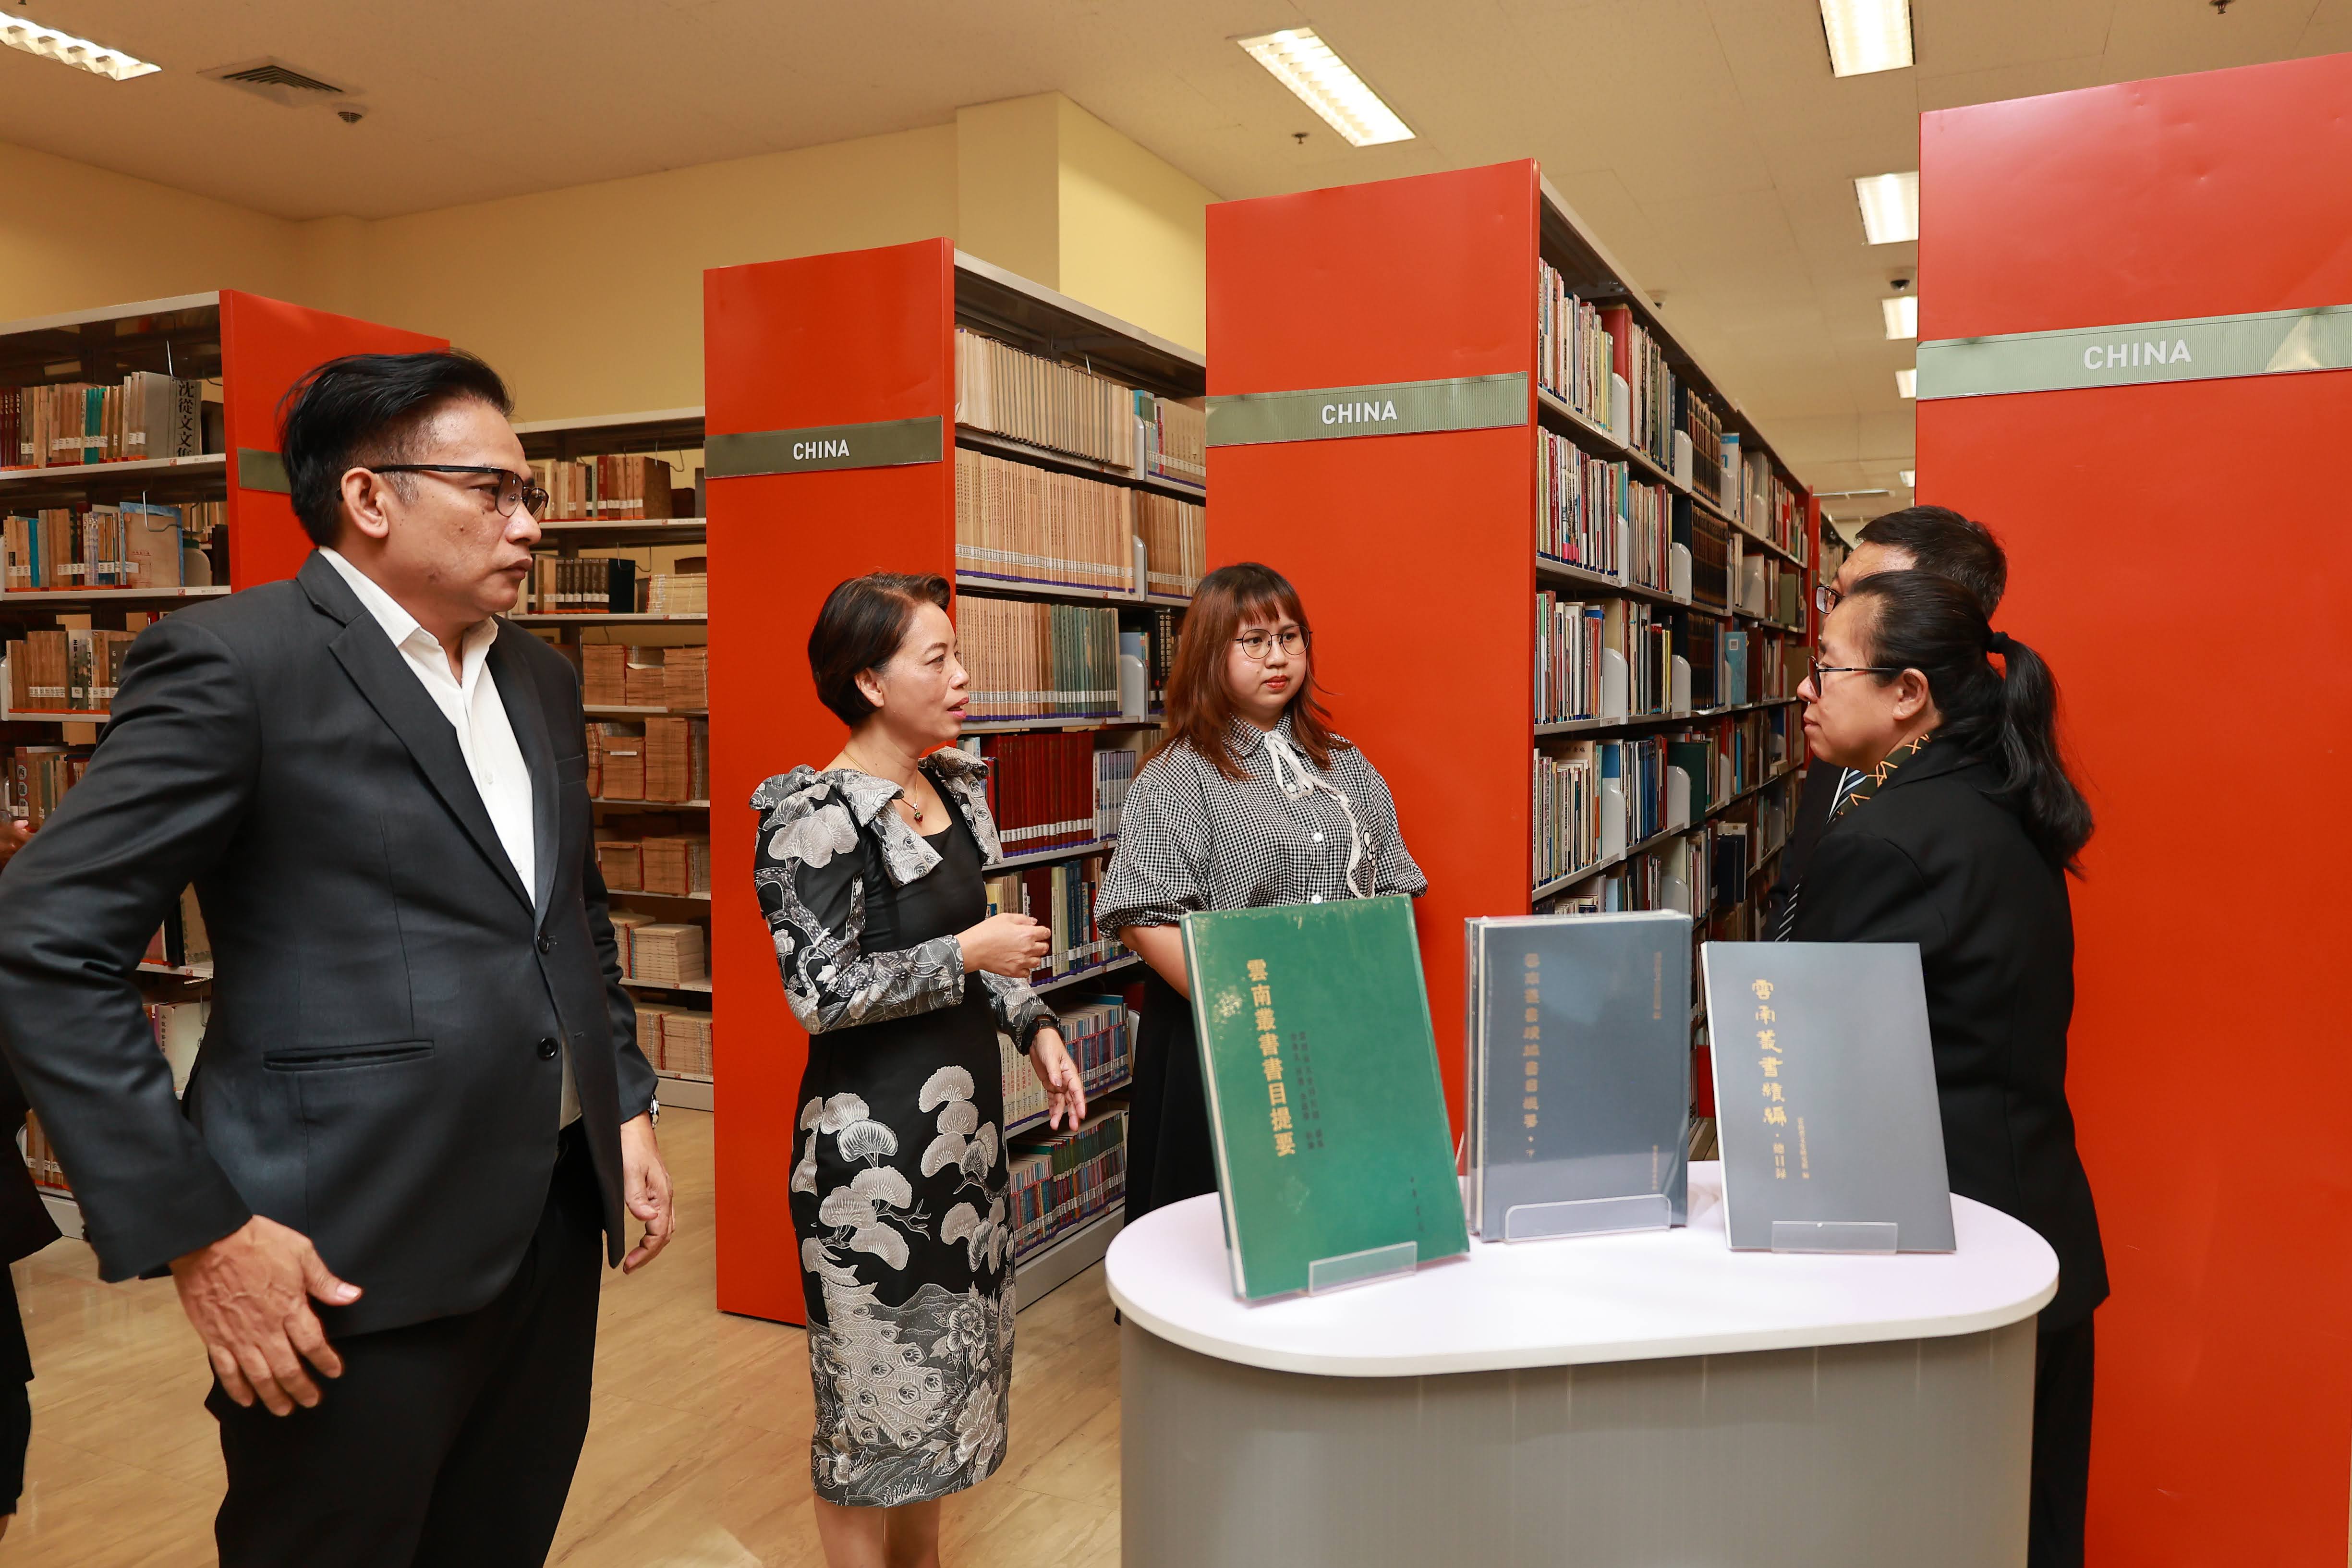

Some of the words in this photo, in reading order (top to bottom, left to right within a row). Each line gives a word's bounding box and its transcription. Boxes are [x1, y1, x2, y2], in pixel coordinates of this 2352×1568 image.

[2084, 339, 2192, 369] CHINA
[1322, 401, 1397, 425] CHINA
[793, 439, 850, 460] CHINA
